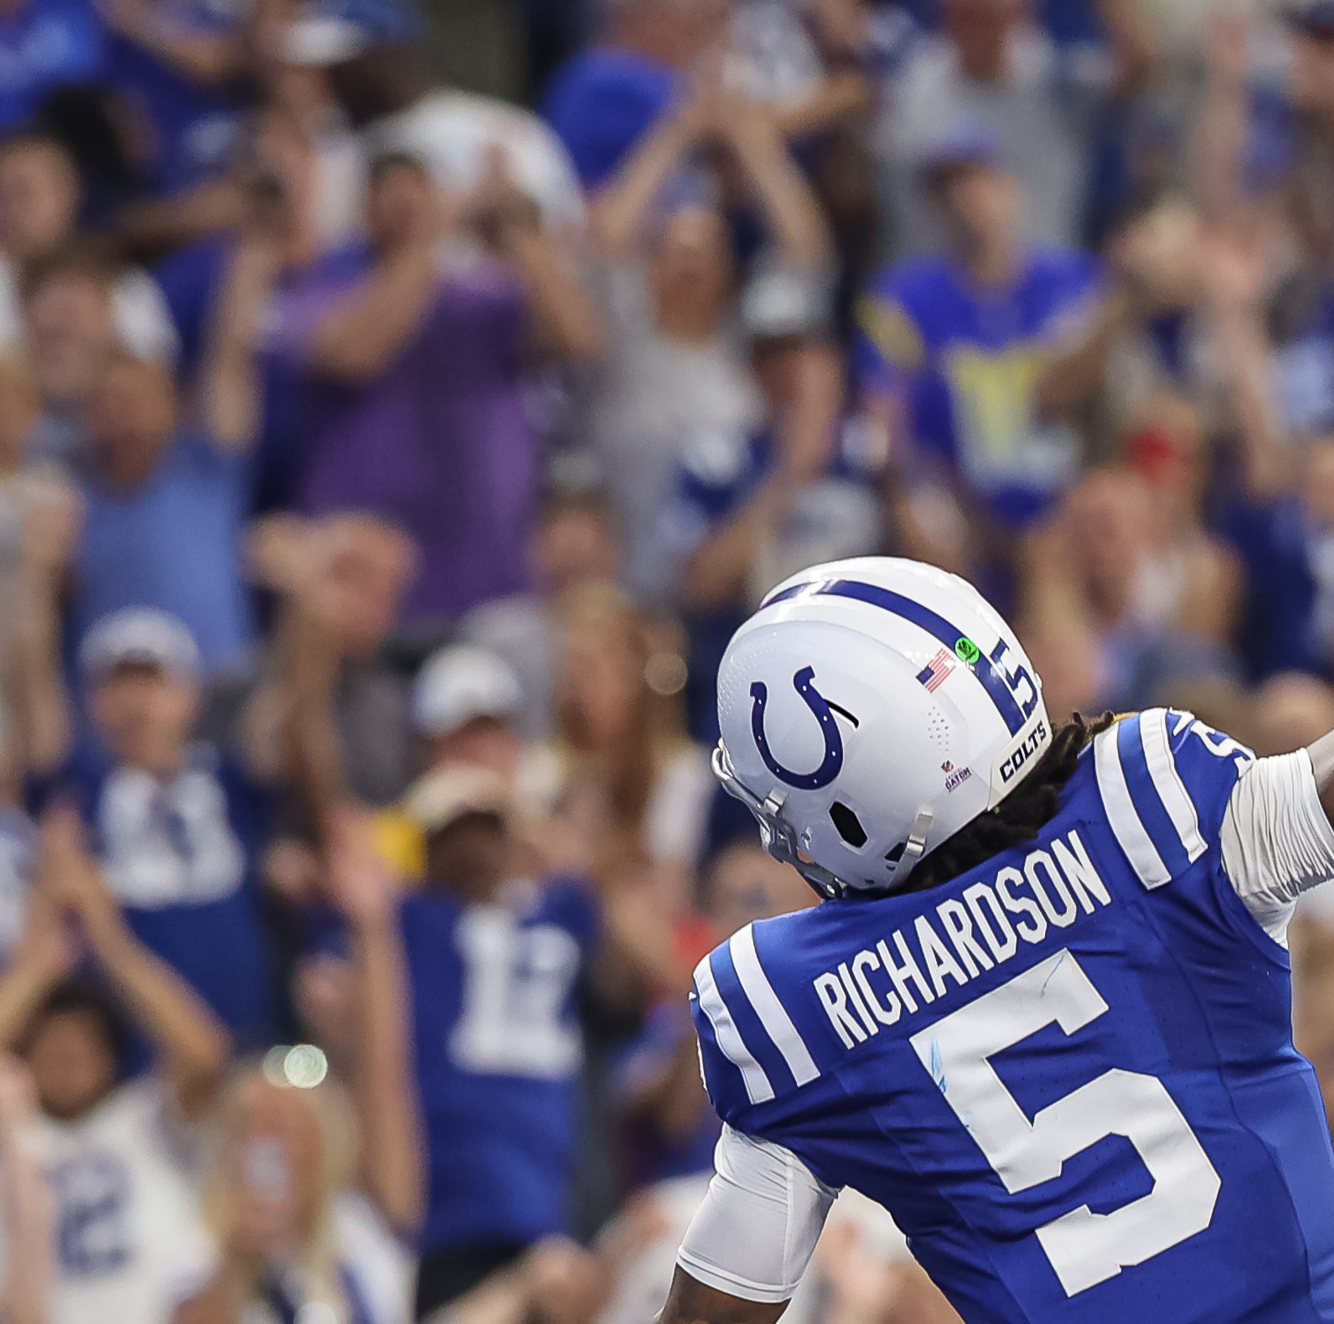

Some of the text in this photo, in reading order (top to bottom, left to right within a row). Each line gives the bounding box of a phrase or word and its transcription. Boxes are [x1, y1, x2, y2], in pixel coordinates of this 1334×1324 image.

[989, 637, 1039, 719] 5
[999, 720, 1047, 783] COLTS
[448, 902, 584, 1080] 12
[813, 829, 1111, 1050] RICHARDSON
[909, 947, 1221, 1297] 5
